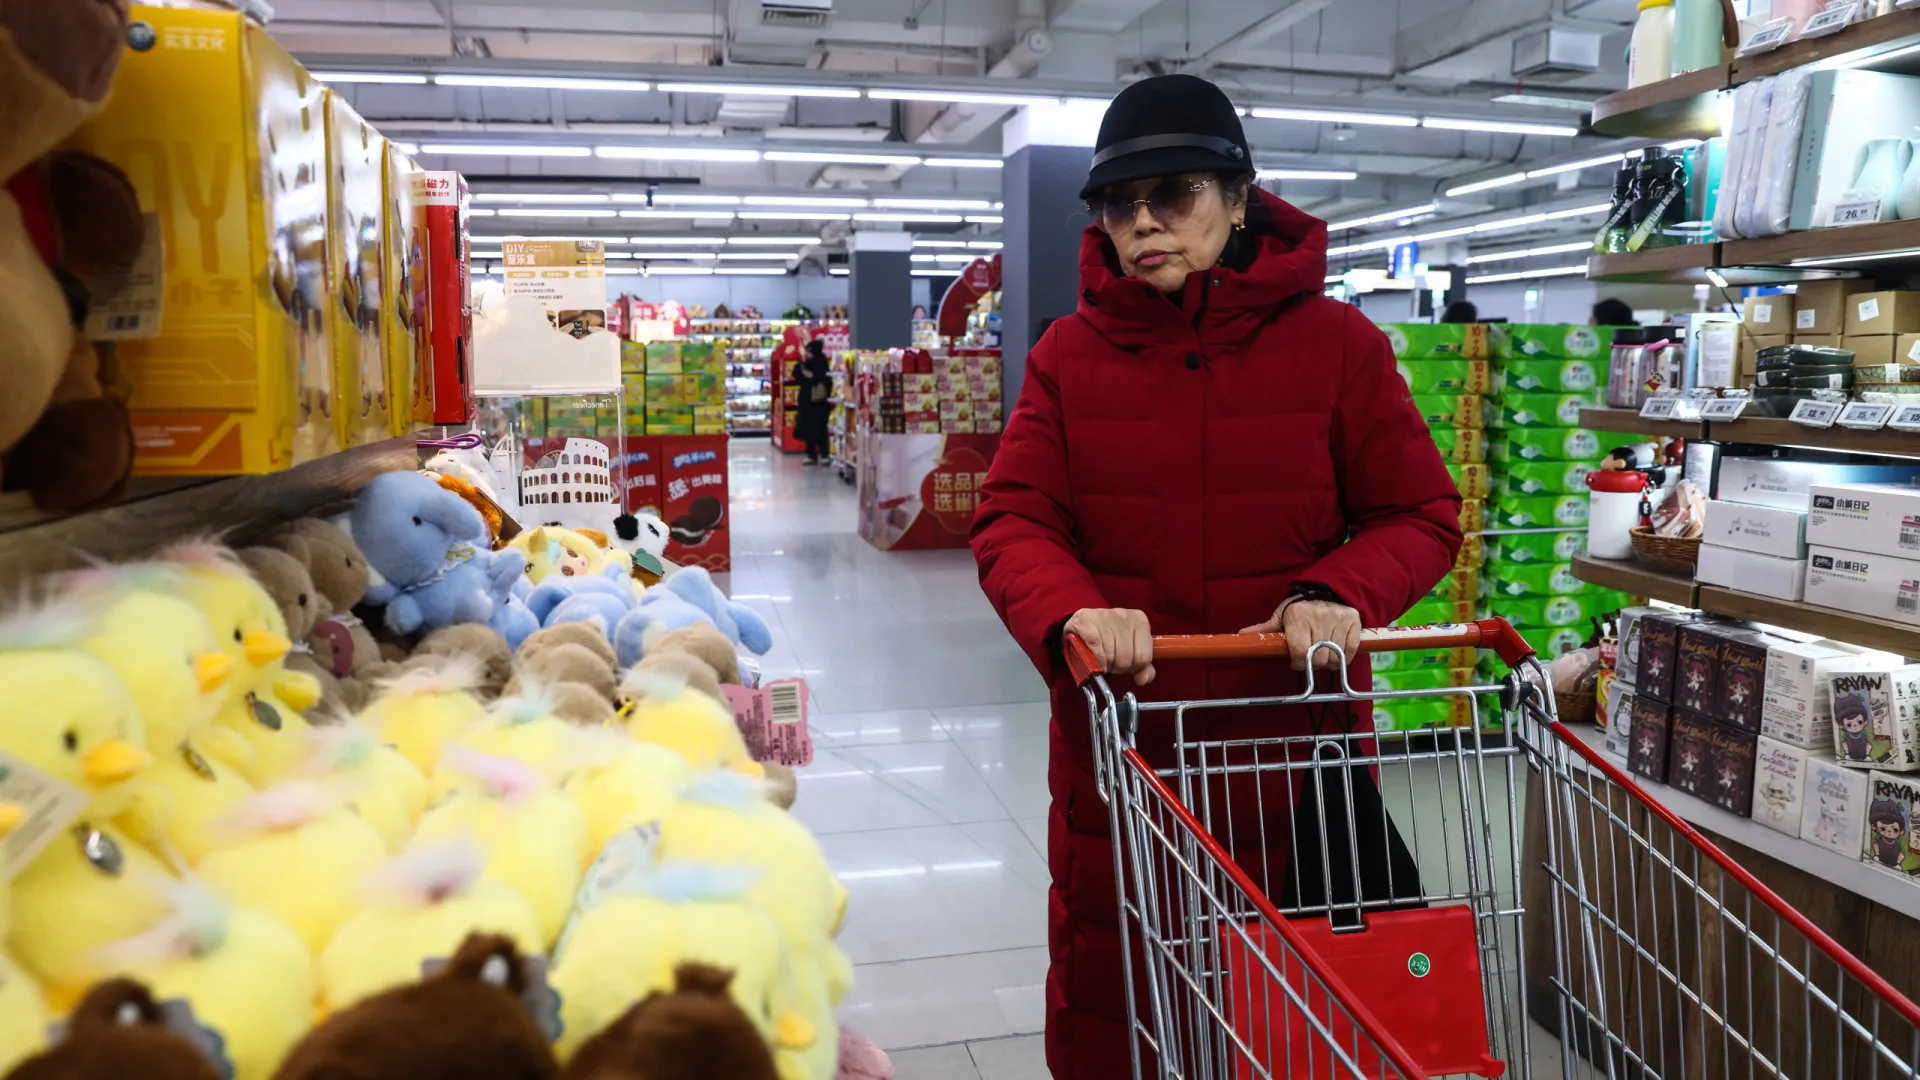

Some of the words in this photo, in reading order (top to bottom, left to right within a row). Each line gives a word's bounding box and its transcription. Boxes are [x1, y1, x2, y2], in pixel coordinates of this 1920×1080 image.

[506, 243, 525, 253] DIY
[506, 253, 536, 265] 音乐盒
[1835, 559, 1869, 574] 小城日记
